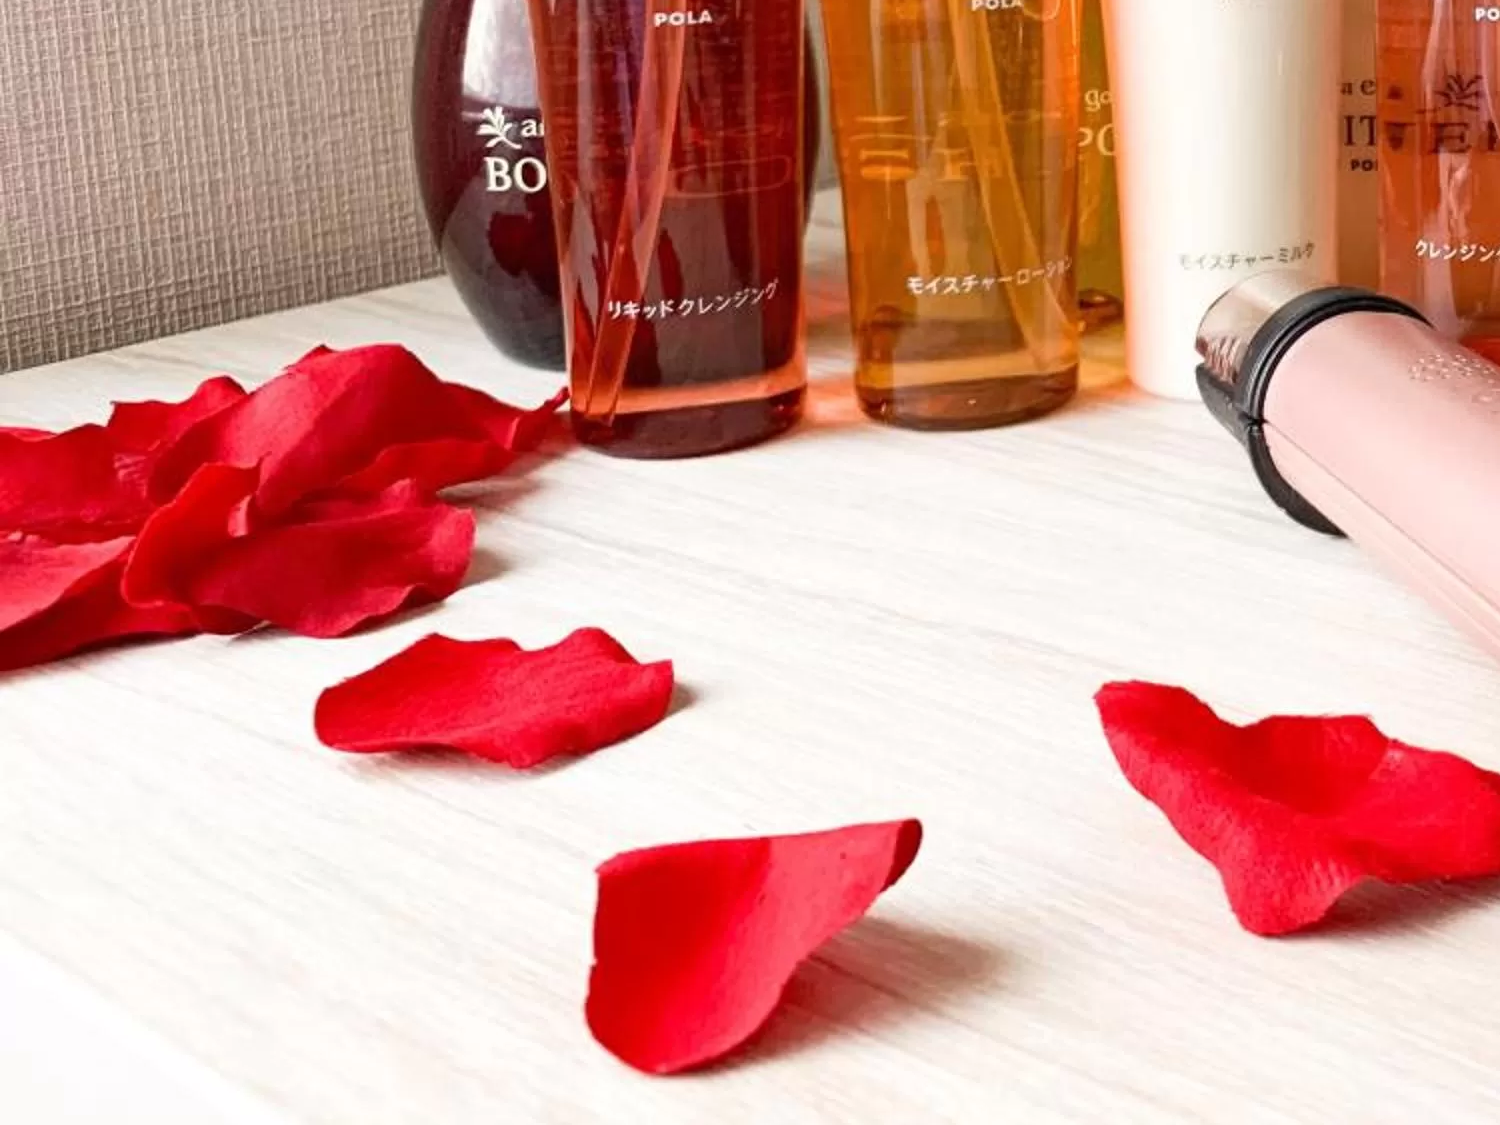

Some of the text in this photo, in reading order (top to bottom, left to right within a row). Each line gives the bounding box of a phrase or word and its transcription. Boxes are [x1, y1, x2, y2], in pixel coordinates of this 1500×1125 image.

[654, 9, 713, 27] POLA
[483, 156, 549, 194] BO
[607, 277, 781, 321] リキッドクレンジング
